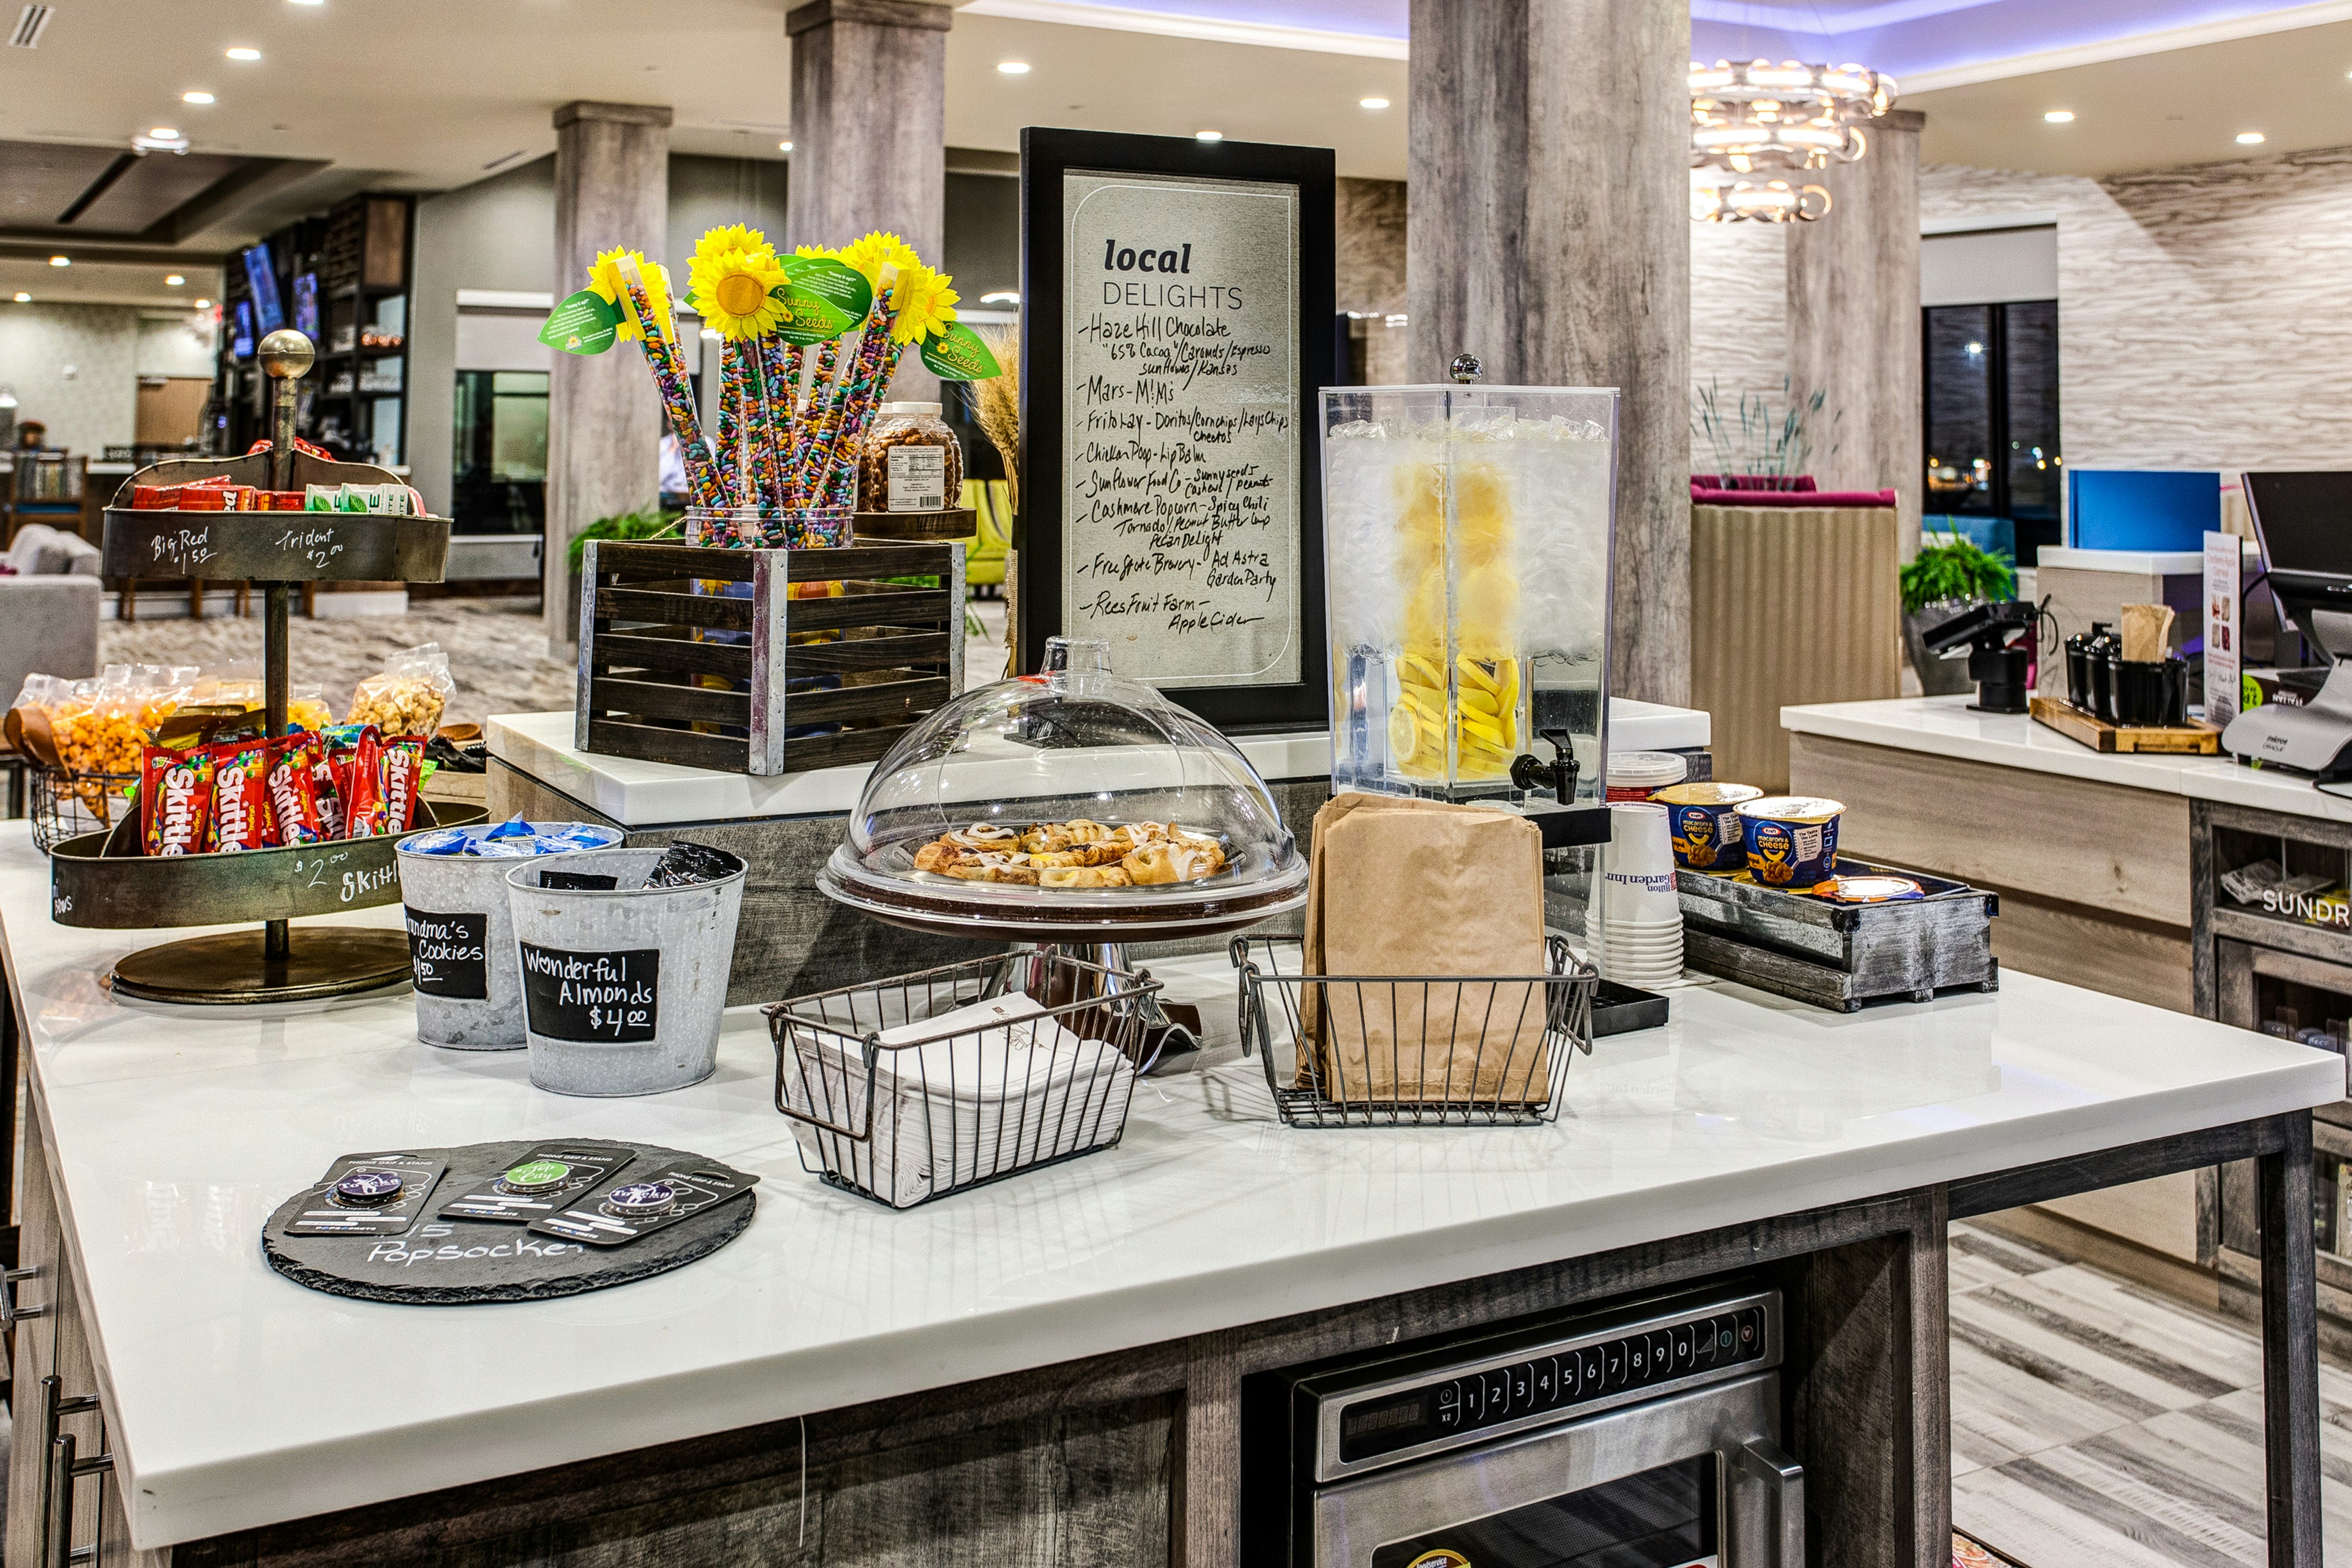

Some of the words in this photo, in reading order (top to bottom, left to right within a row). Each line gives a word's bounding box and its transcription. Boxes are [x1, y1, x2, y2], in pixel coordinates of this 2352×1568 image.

[1104, 239, 1191, 274] local
[777, 287, 820, 316] Sunny
[1104, 282, 1242, 310] DELIGHTS
[795, 309, 833, 329] Seeds
[1137, 313, 1161, 341] Hill
[1166, 316, 1231, 337] Chocolate
[944, 322, 980, 359] Sunny
[947, 346, 983, 374] Seeds
[151, 531, 178, 562] Big
[179, 526, 208, 550] Red
[387, 748, 409, 834] Skittle
[161, 767, 194, 857] Skittle
[217, 767, 248, 853] Skittle
[340, 860, 398, 903] Skittl
[1607, 873, 1628, 885] Inn
[1630, 875, 1670, 885] Garden
[2263, 889, 2350, 927] SUNDR
[406, 918, 469, 940] randma's
[419, 941, 483, 960] Cookies
[524, 948, 626, 982] Wonderful
[559, 981, 652, 1006] Almonds
[667, 1171, 691, 1180] PHONE
[1469, 1394, 1474, 1408] 1
[1492, 1388, 1500, 1402] 2
[1516, 1382, 1525, 1396] 3
[1540, 1376, 1549, 1389] 4
[1564, 1370, 1572, 1384] 5
[1587, 1364, 1596, 1378] 6
[1611, 1358, 1619, 1373] 7
[1634, 1353, 1642, 1367] 8
[1656, 1347, 1665, 1362] 9
[1679, 1342, 1687, 1356] 0
